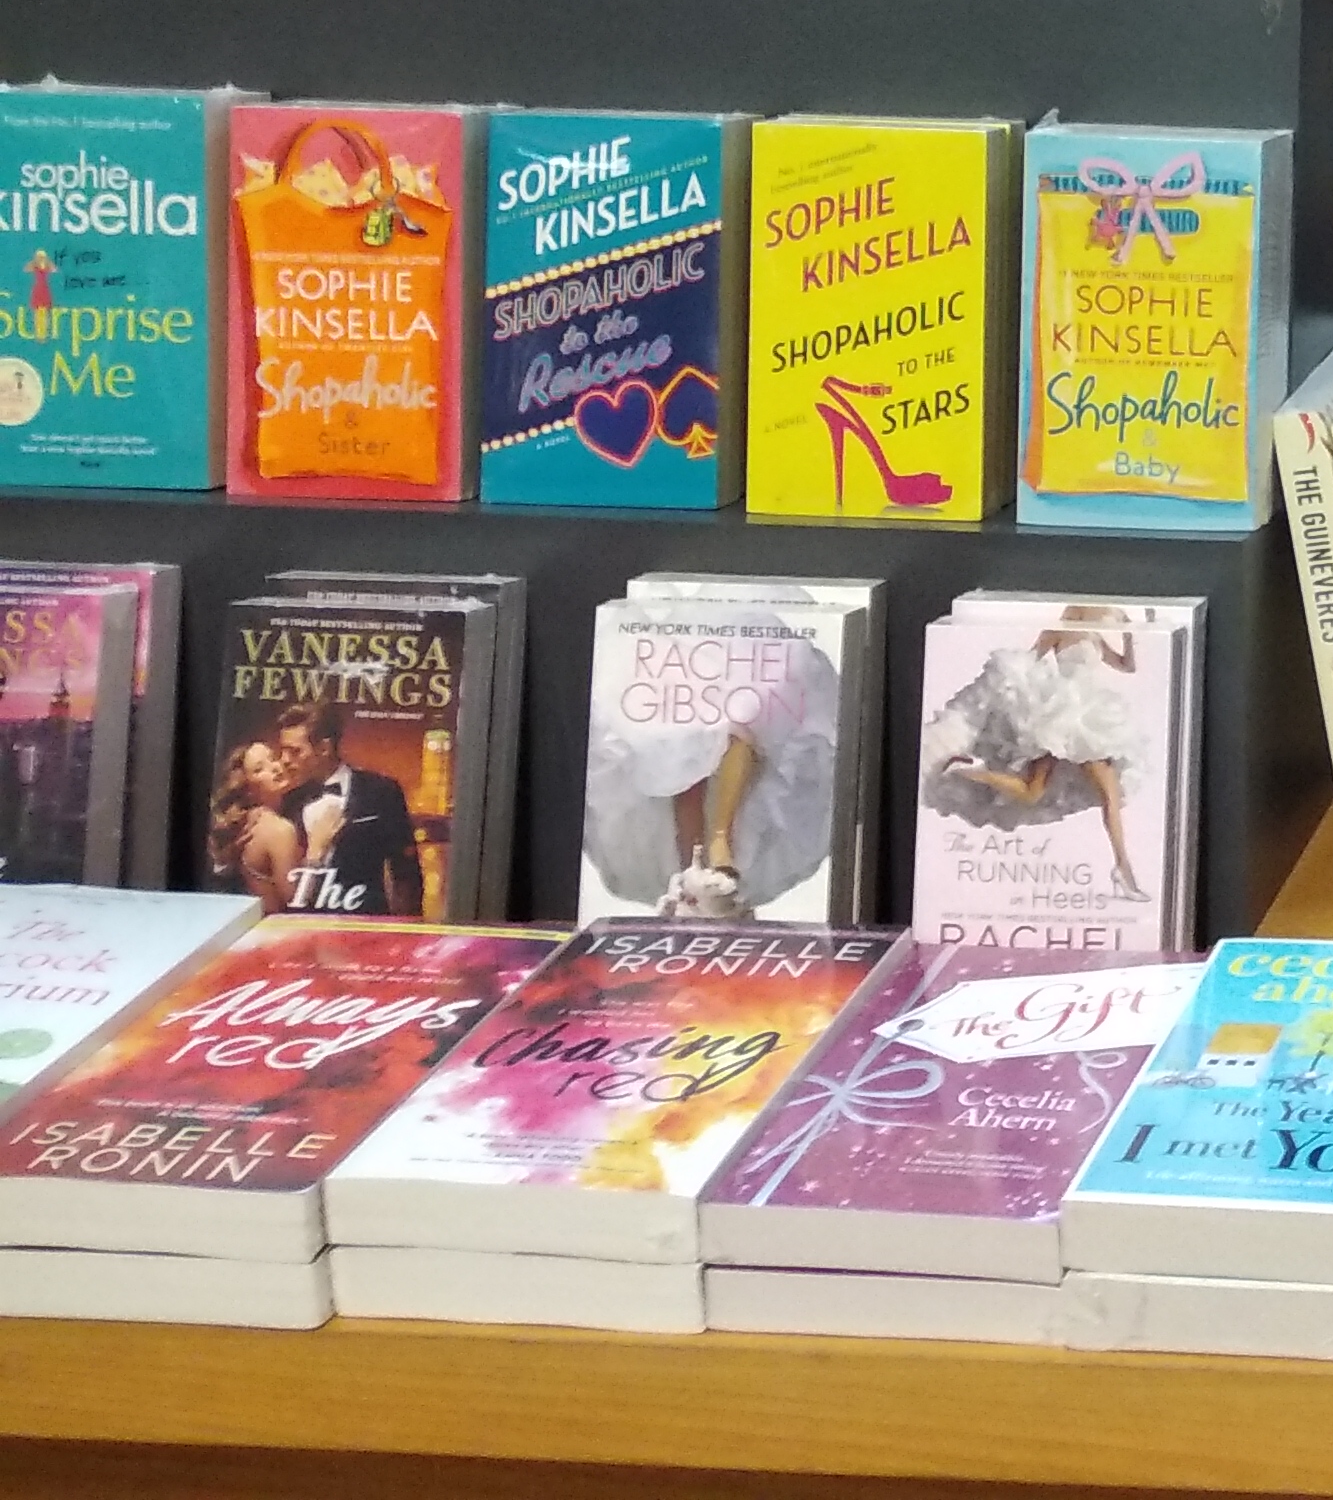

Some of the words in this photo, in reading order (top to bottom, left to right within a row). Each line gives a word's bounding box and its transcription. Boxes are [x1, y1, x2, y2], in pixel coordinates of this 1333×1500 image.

[20, 149, 130, 200] sophie
[497, 134, 632, 213] SOPHIE
[534, 171, 708, 256] KINSELLA
[764, 177, 897, 250] SOPHIE
[801, 215, 973, 294] KINSELLA
[277, 268, 413, 303] SOPHIE
[492, 242, 706, 342] SHOPAHOLIC
[1076, 284, 1214, 319] SOPHIE
[254, 305, 438, 342] KINSELLA
[559, 328, 590, 356] to
[593, 310, 639, 348] the
[770, 291, 967, 375] SHOPAHOLIC
[1051, 322, 1238, 358] KINSELLA
[50, 350, 136, 398] Me
[518, 334, 674, 413] Rescue
[896, 359, 918, 378] TO
[923, 347, 956, 370] THE
[254, 353, 438, 425] Shopaholic
[880, 383, 972, 436] STARS
[1046, 370, 1240, 443] Shopaholic
[317, 431, 391, 456] Sister
[1113, 452, 1181, 483] Baby
[1292, 466, 1319, 507] THE
[239, 629, 450, 671] VANESSA
[618, 622, 652, 637] NEW
[655, 622, 693, 638] YORK
[697, 623, 736, 638] TIMES
[739, 624, 817, 641] BESTSELLER
[634, 637, 793, 685] RACHEL
[232, 665, 452, 708] FEWINGS
[619, 685, 806, 726] GIBSON
[981, 833, 1025, 854] Art
[1031, 834, 1053, 855] of
[287, 867, 367, 912] The
[956, 860, 1092, 884] RUNNING
[1031, 887, 1108, 911] Heels
[586, 933, 873, 963] ISABELLE
[608, 953, 814, 980] RONIN
[155, 978, 484, 1034] Always
[948, 1014, 1015, 1039] The
[997, 982, 1185, 1051] Gift
[473, 1024, 790, 1074] Chasing
[956, 1086, 1077, 1113] Cecelia
[1212, 1098, 1269, 1122] The
[10, 1120, 338, 1160] ISABELLE
[948, 1108, 1058, 1134] Ahern
[1113, 1121, 1156, 1165] I
[1163, 1133, 1258, 1161] met
[26, 1146, 263, 1184] RONIN
